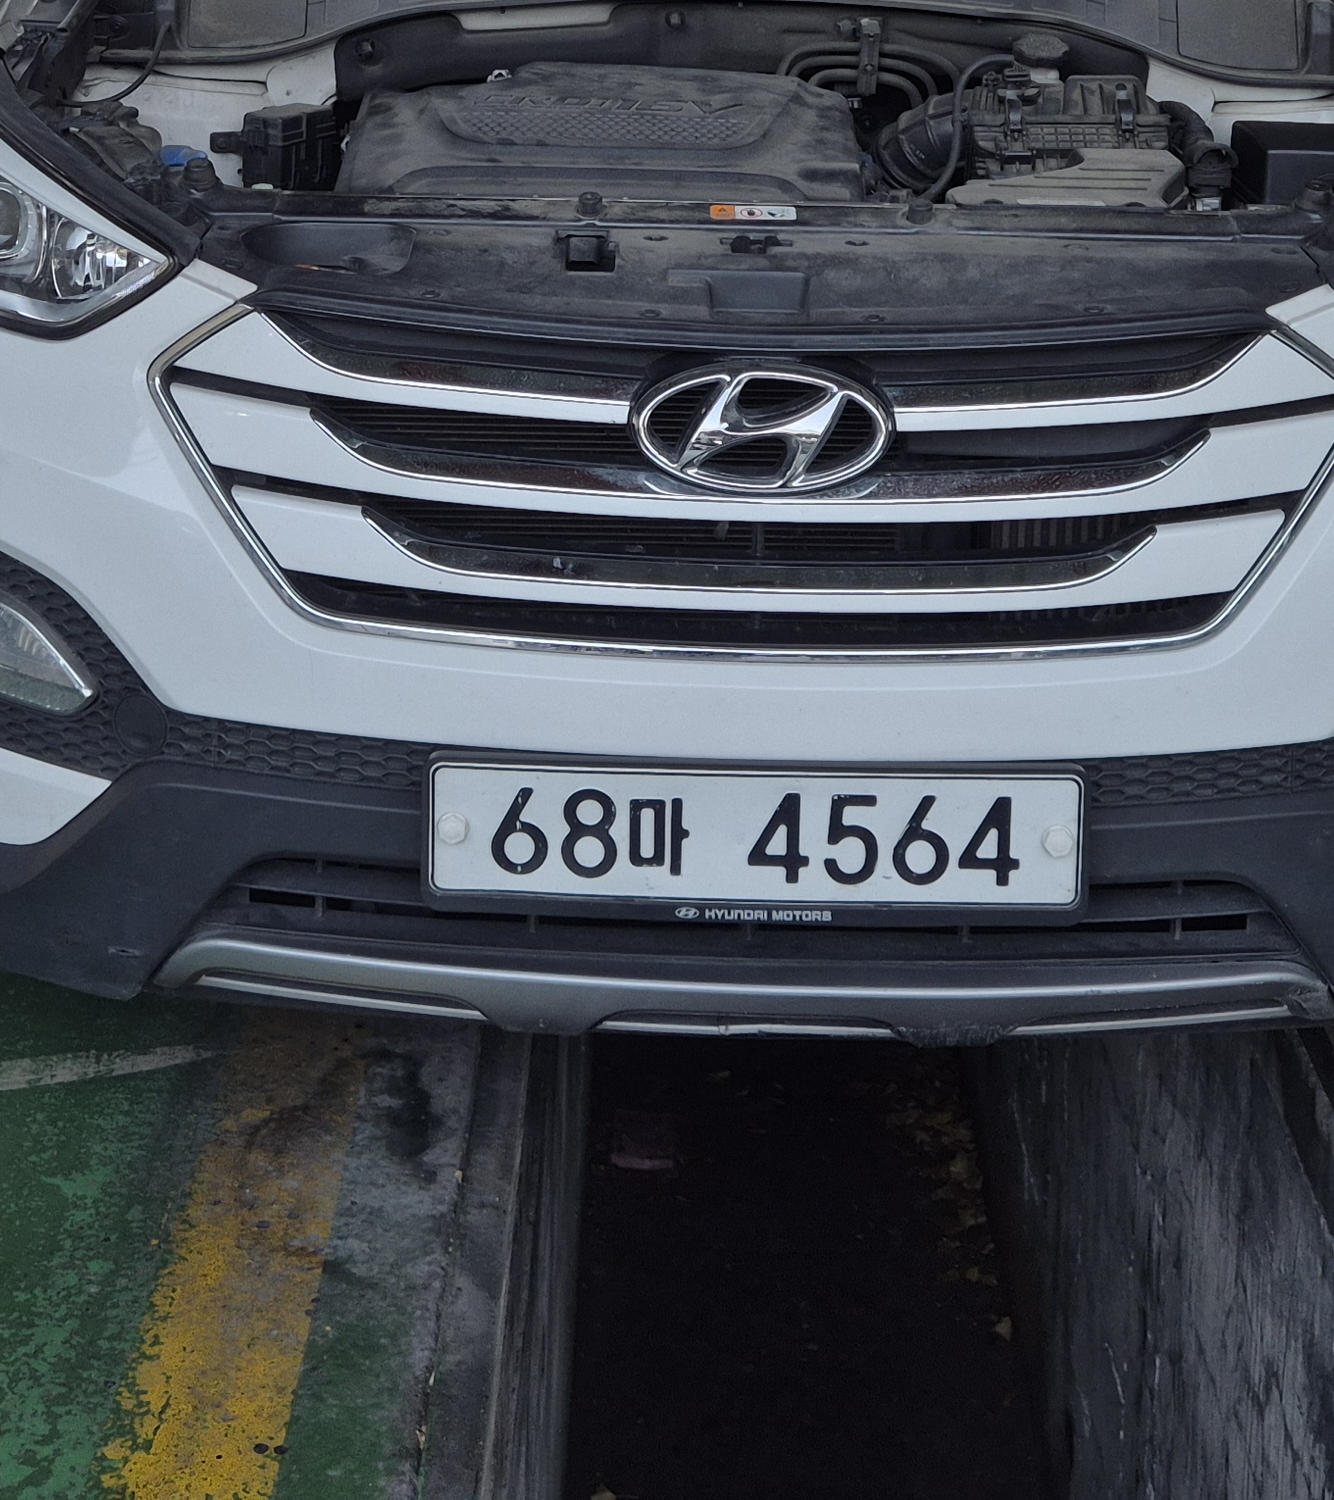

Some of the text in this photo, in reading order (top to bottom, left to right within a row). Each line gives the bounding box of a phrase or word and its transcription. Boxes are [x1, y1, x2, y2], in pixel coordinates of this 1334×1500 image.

[491, 787, 1020, 886] 68마 4564
[705, 908, 832, 921] HYUNDAI MOTORS
